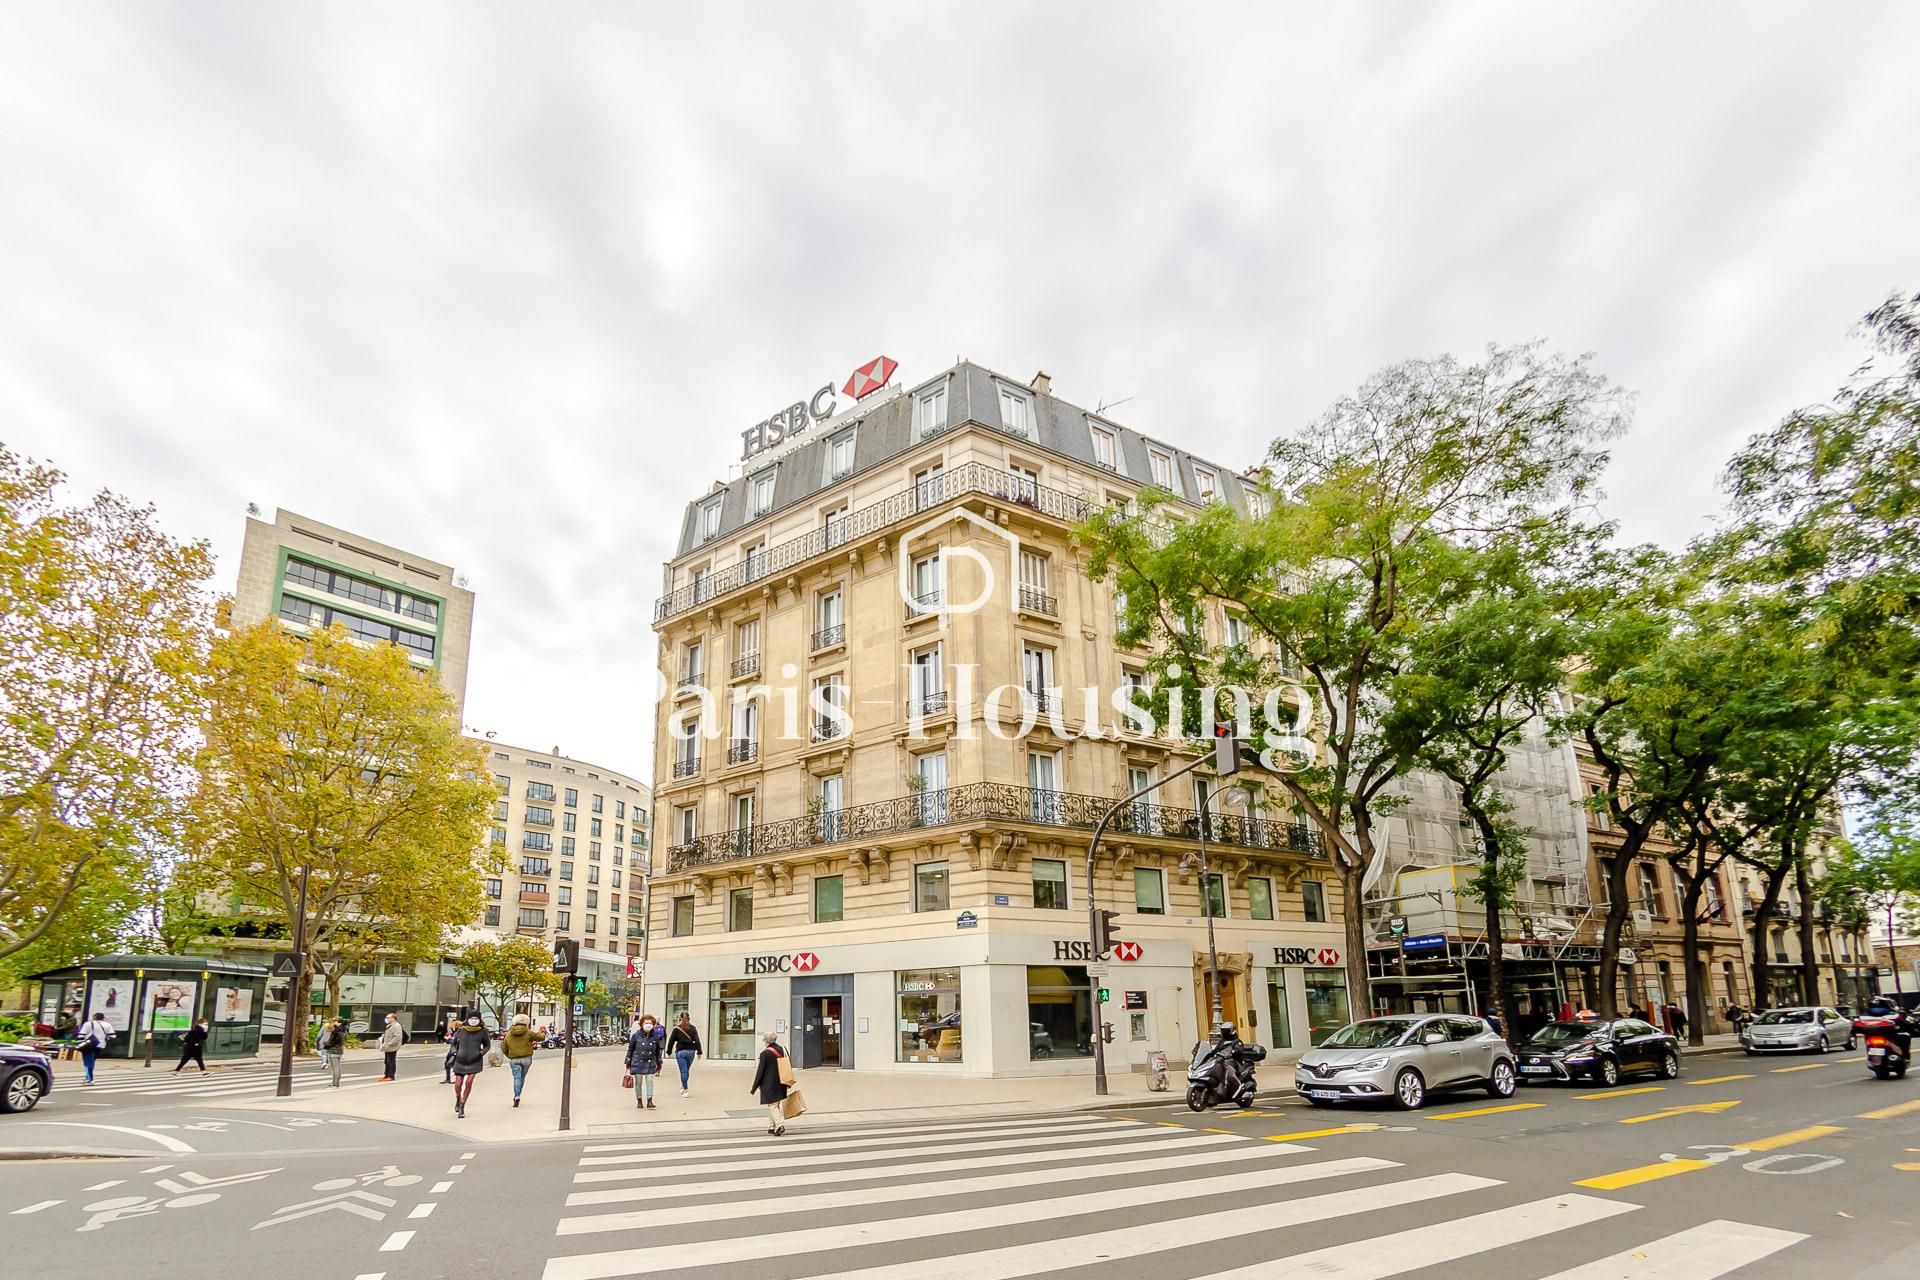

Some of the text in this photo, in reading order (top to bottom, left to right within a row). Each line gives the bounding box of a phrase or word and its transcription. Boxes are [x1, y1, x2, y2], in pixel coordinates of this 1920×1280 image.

[741, 382, 836, 461] HSBC
[1391, 918, 1404, 926] BUS
[744, 954, 792, 975] HSBC
[1273, 948, 1317, 965] HSBC
